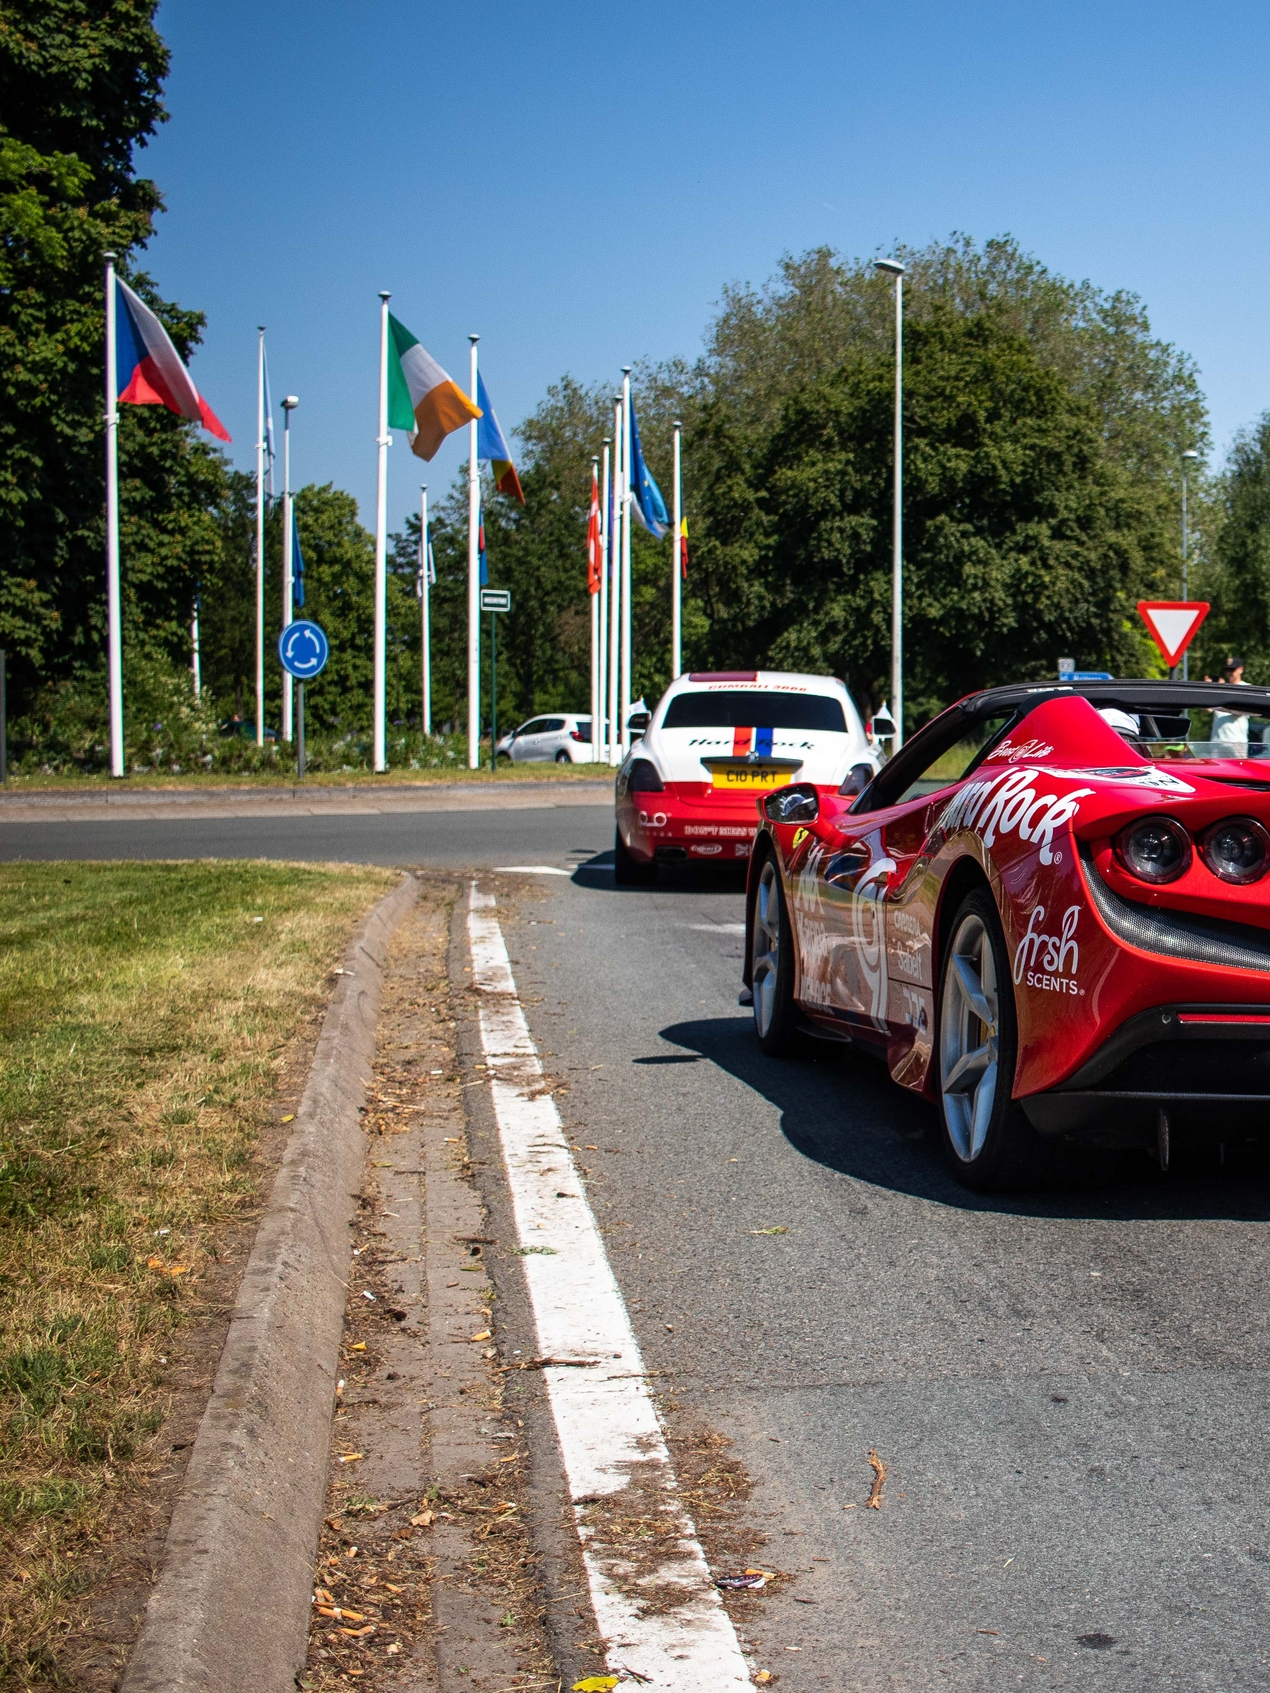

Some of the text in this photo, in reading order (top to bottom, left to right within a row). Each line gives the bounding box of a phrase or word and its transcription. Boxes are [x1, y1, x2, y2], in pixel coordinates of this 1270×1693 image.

[689, 738, 815, 750] Hard Rock
[751, 771, 778, 783] PRT
[1013, 905, 1082, 985] frsh
[1027, 971, 1078, 995] SCENTS
